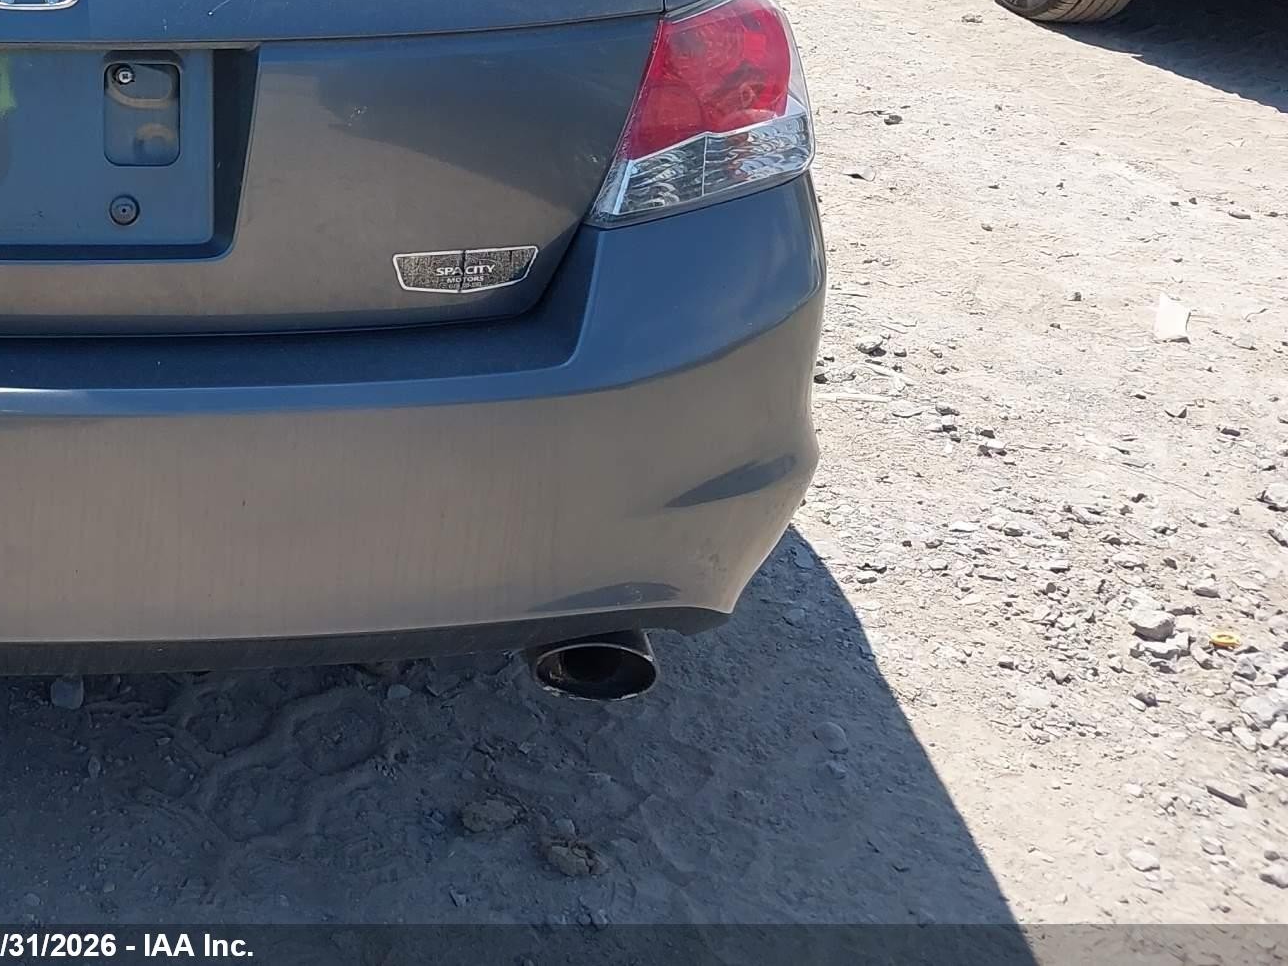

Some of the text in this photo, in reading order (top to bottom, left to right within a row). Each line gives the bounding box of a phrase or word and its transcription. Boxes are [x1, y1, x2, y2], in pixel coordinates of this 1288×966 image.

[436, 264, 495, 276] SPA CITY
[446, 275, 484, 284] MOTORS
